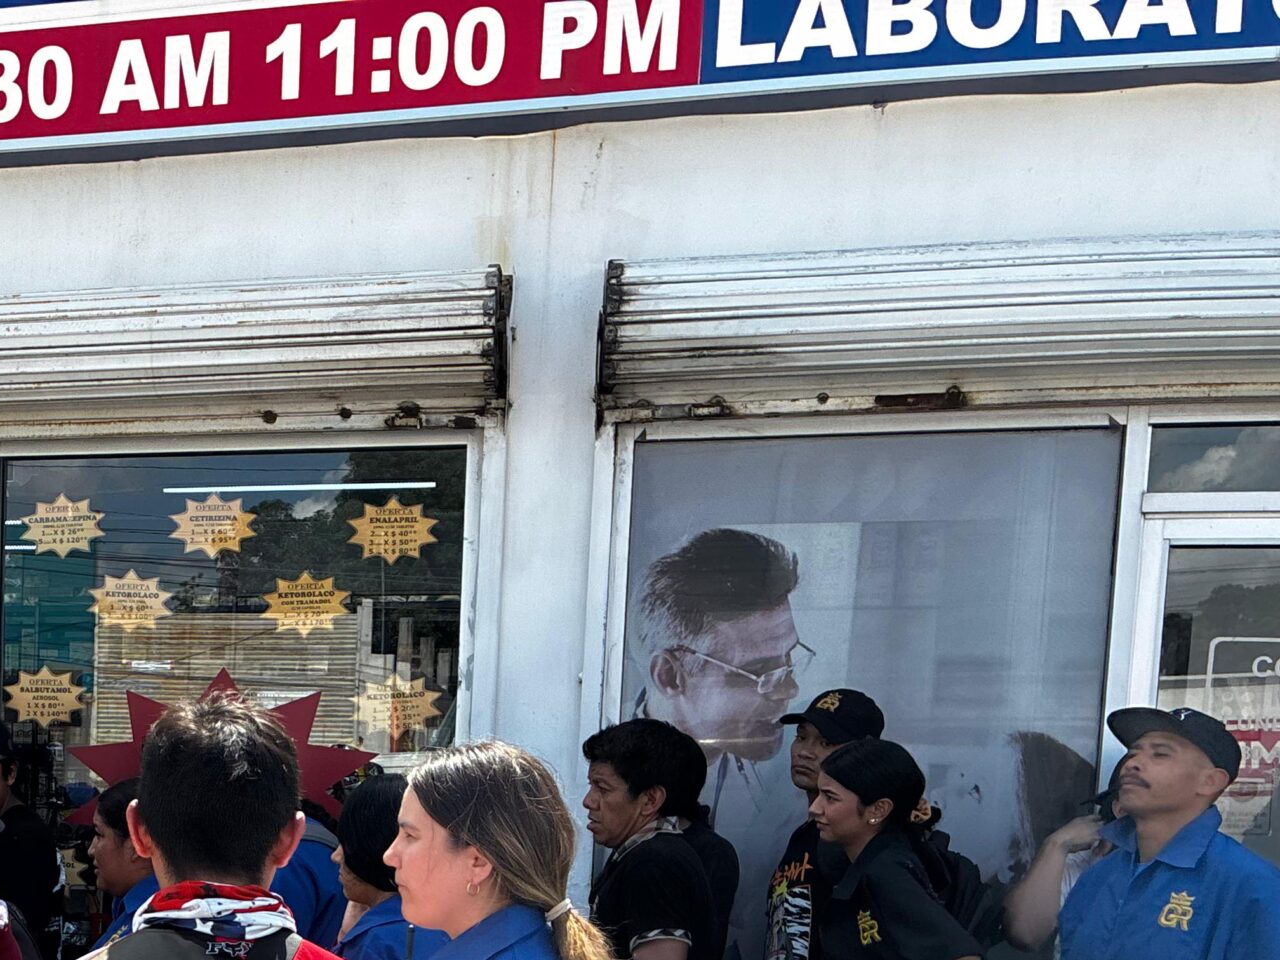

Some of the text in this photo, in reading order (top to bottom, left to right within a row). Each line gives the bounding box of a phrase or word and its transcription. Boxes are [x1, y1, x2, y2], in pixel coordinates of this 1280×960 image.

[100, 31, 229, 114] AM
[266, 7, 505, 99] 11:00
[541, 0, 680, 79] PM
[375, 507, 413, 515] OFERTA
[115, 583, 150, 591] OFERTA
[287, 582, 325, 590] OFERTA
[105, 591, 159, 599] KETOROLACO
[278, 590, 335, 599] KETOROLACO
[367, 692, 425, 700] KETOROLACO
